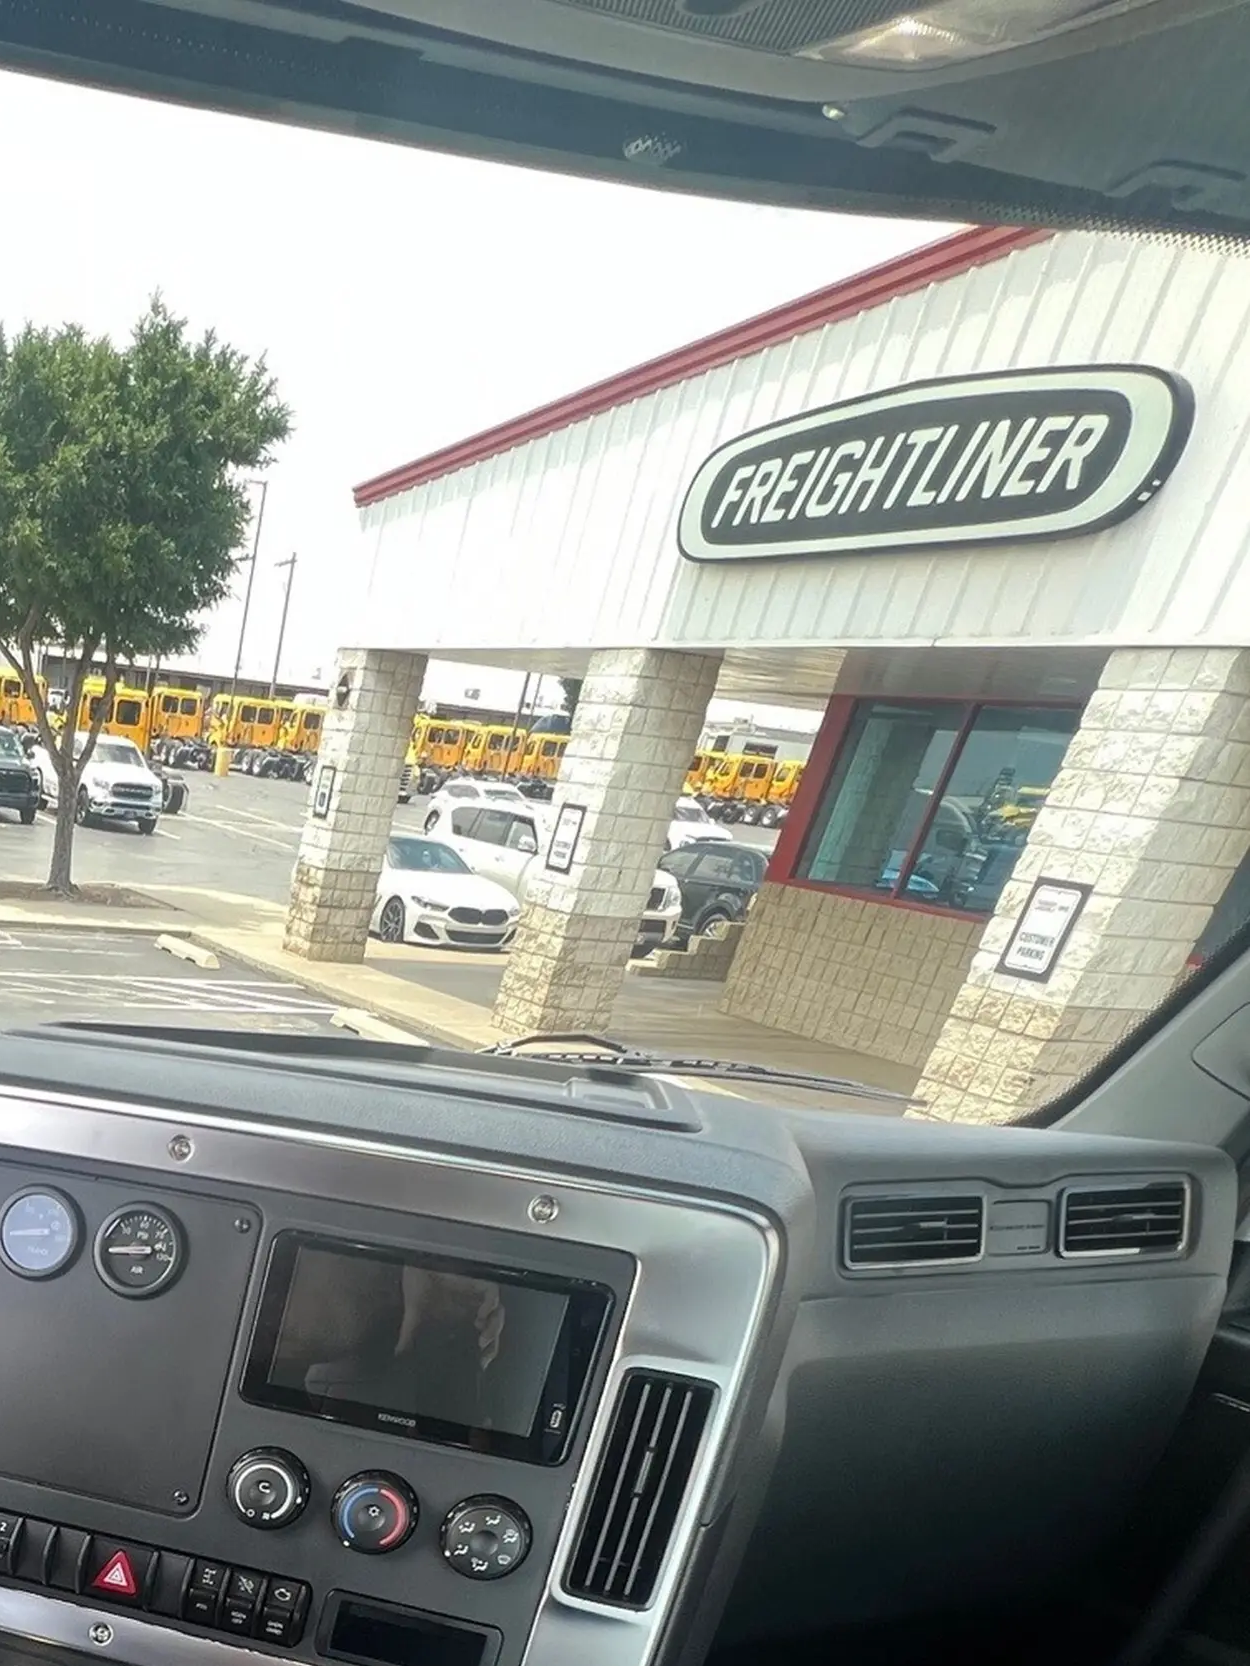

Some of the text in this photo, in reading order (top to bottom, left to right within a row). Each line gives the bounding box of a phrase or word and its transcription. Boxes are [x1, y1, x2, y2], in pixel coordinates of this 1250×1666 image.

[711, 413, 1111, 530] FREIGHTLINER
[1020, 931, 1056, 948] CUSTOMER
[1016, 946, 1046, 961] PARKING
[378, 1412, 417, 1427] KENWOOD
[0, 1521, 8, 1532] 2
